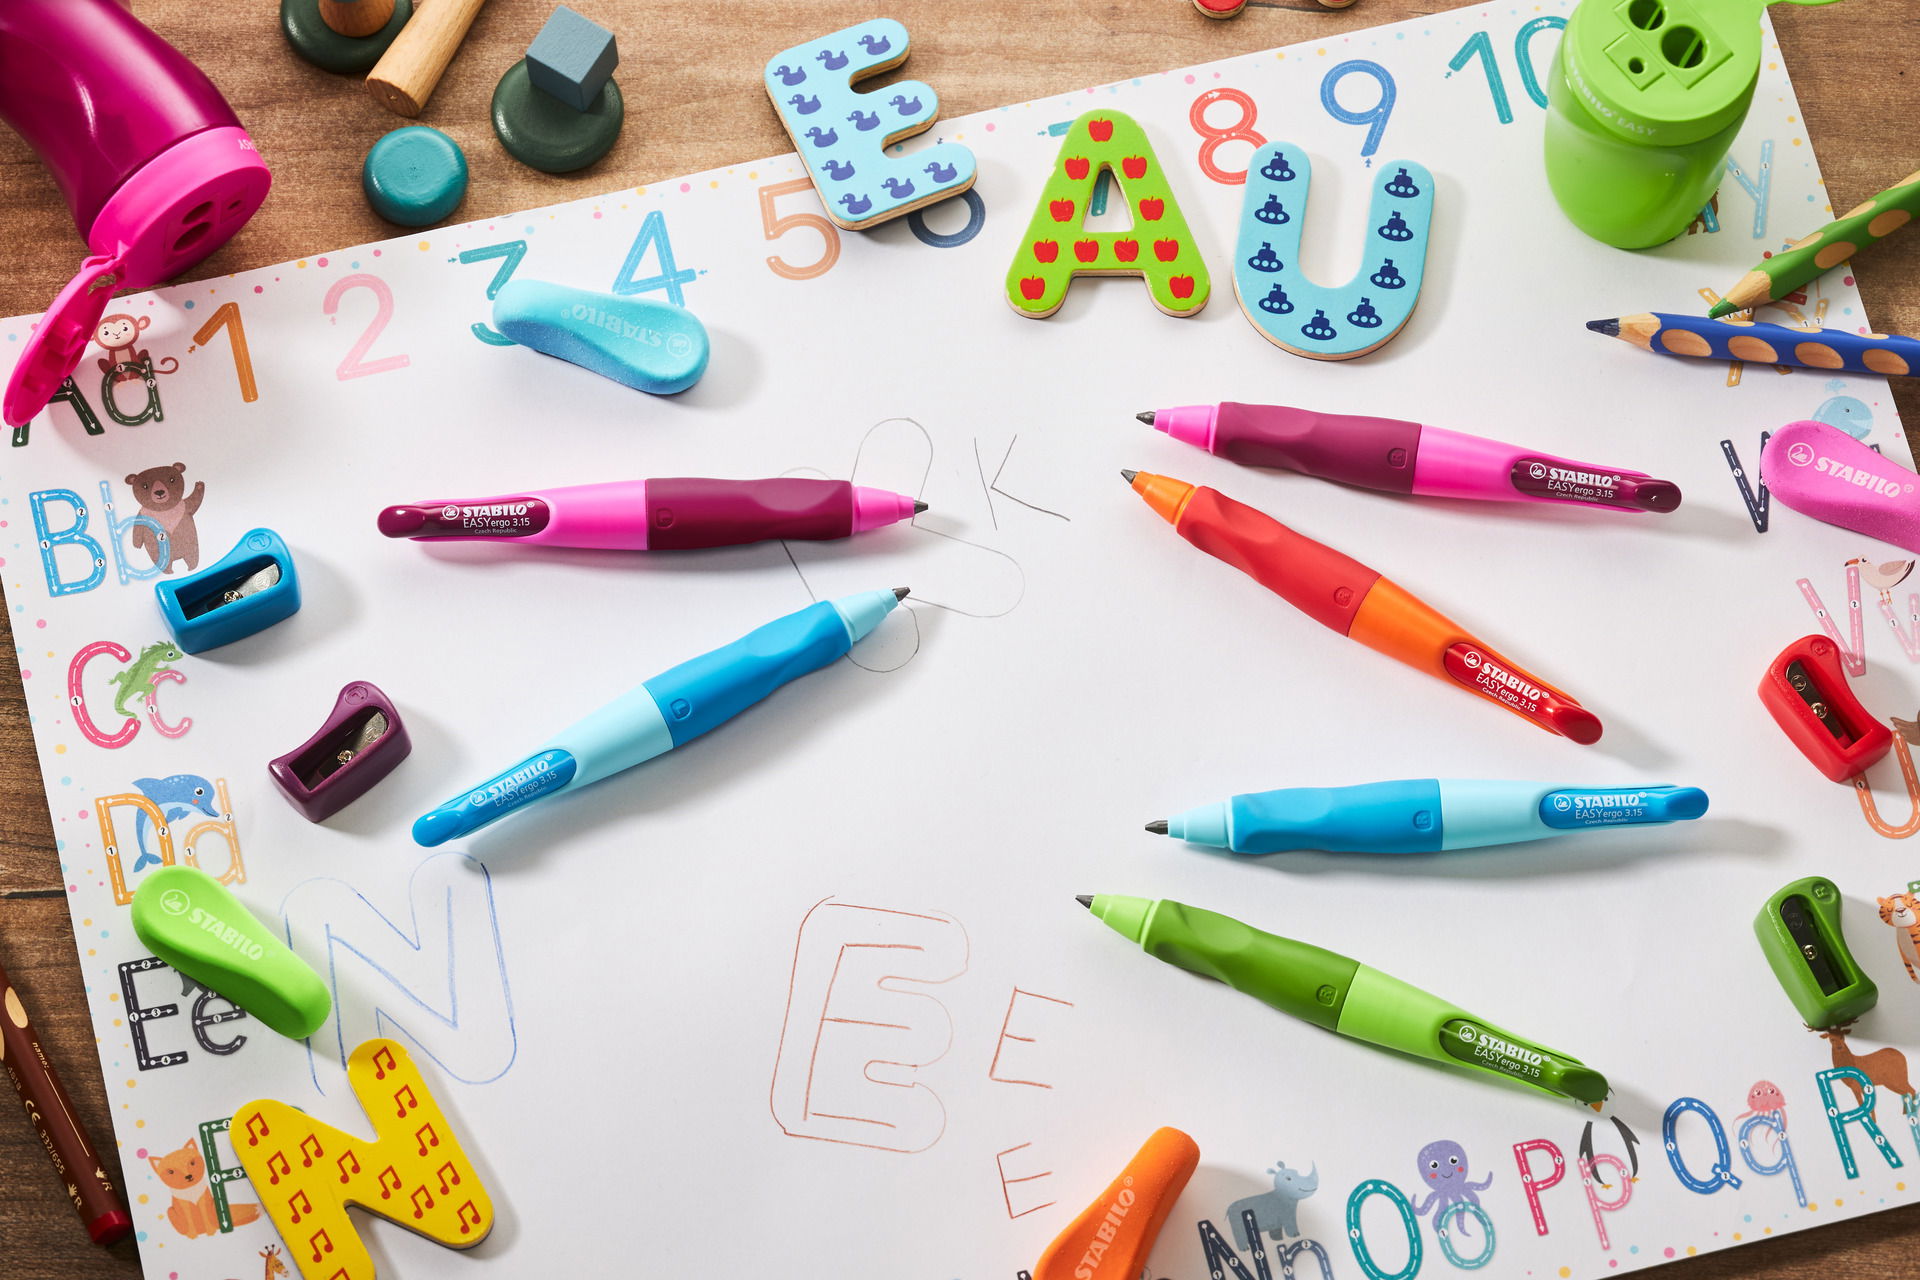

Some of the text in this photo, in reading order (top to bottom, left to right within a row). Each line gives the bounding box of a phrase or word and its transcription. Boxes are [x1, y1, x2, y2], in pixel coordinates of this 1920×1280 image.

[1448, 16, 1568, 124] 10
[765, 17, 977, 231] E
[1320, 59, 1397, 157] 9
[1617, 117, 1656, 137] EASY
[1190, 88, 1270, 185] 8
[758, 177, 841, 280] 5
[1005, 108, 1212, 319] A
[612, 210, 697, 308] 4
[1232, 140, 1436, 360] U
[323, 273, 410, 381] 2
[194, 302, 258, 402] 1
[973, 433, 1072, 531] K
[1548, 480, 1614, 498] EASYergo 3.15
[1549, 468, 1613, 487] STABILO
[1814, 456, 1901, 498] STABILO
[462, 505, 528, 518] STABILO
[463, 517, 531, 529] EASYergo 3.15
[1476, 672, 1537, 713] EASYergo 3.15
[1481, 662, 1541, 701] STABILO
[487, 760, 549, 798] STABILO
[494, 770, 558, 807] EASYergo 3.15
[1574, 794, 1640, 809] STABILO
[1575, 808, 1643, 820] EASYergo 3.15
[188, 907, 264, 961] STABILO
[988, 984, 1075, 1090] E
[1478, 1034, 1542, 1066] STABILO
[1474, 1045, 1541, 1078] EASYergo 3.15
[230, 1037, 495, 1280] N
[996, 1141, 1057, 1220] E
[73, 1196, 82, 1211] R
